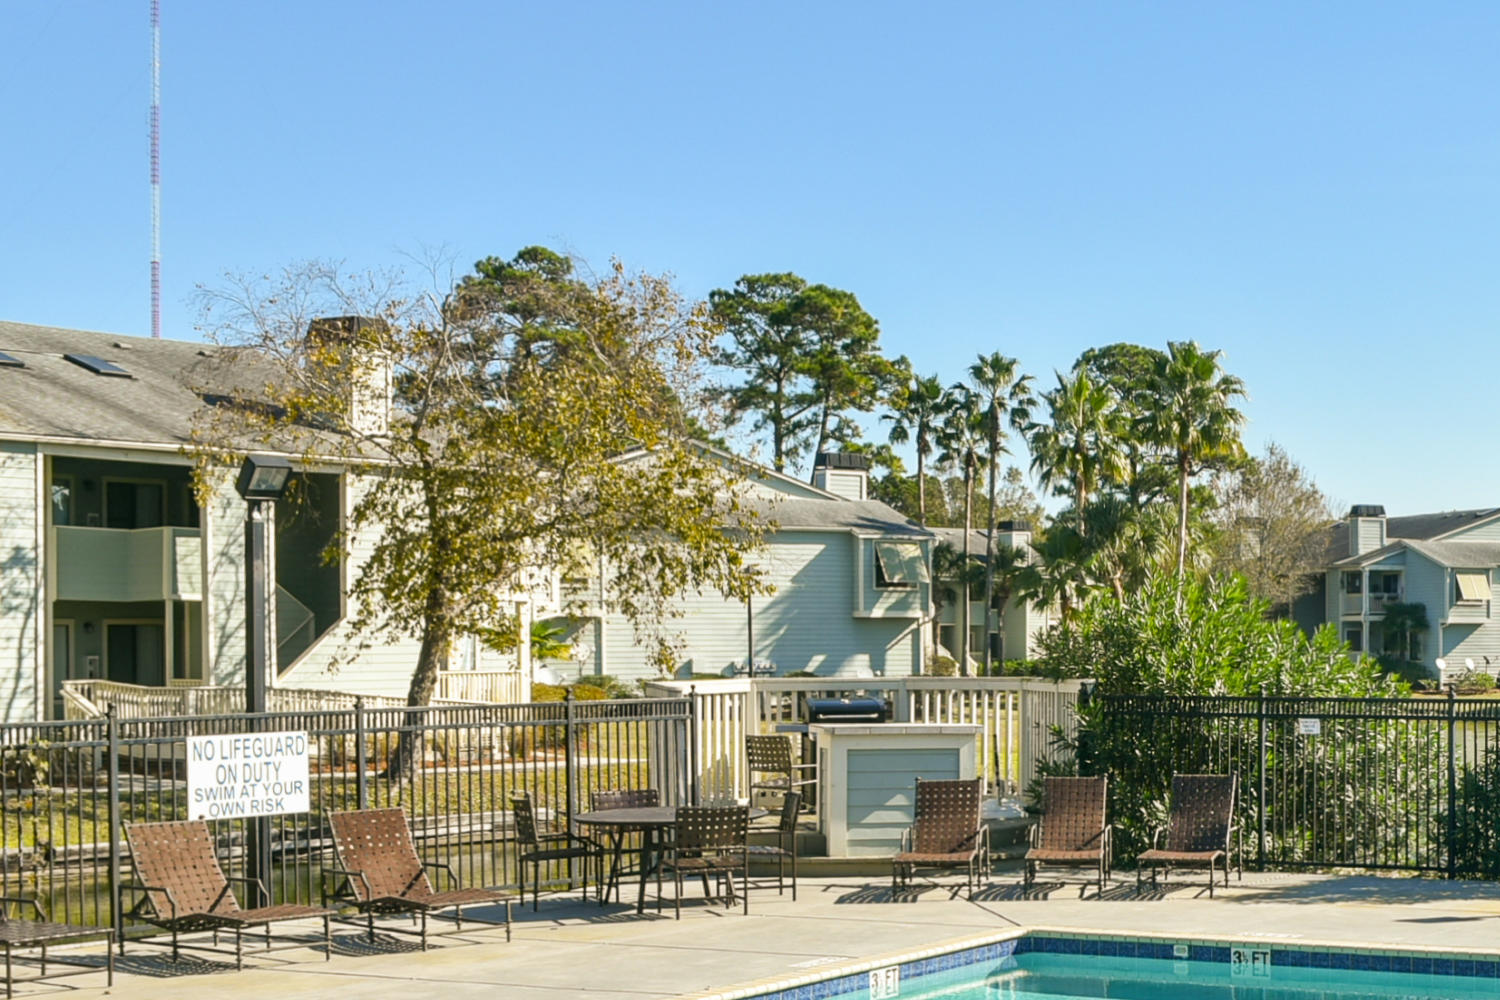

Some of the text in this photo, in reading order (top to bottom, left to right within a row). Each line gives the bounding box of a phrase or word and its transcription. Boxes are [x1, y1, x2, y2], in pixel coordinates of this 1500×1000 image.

[193, 736, 305, 761] NO LIFEGUARD
[216, 761, 281, 785] ON DUTY
[194, 781, 303, 803] SWIM AT YOUR
[209, 797, 285, 818] OWN RISK
[1252, 951, 1269, 965] FT
